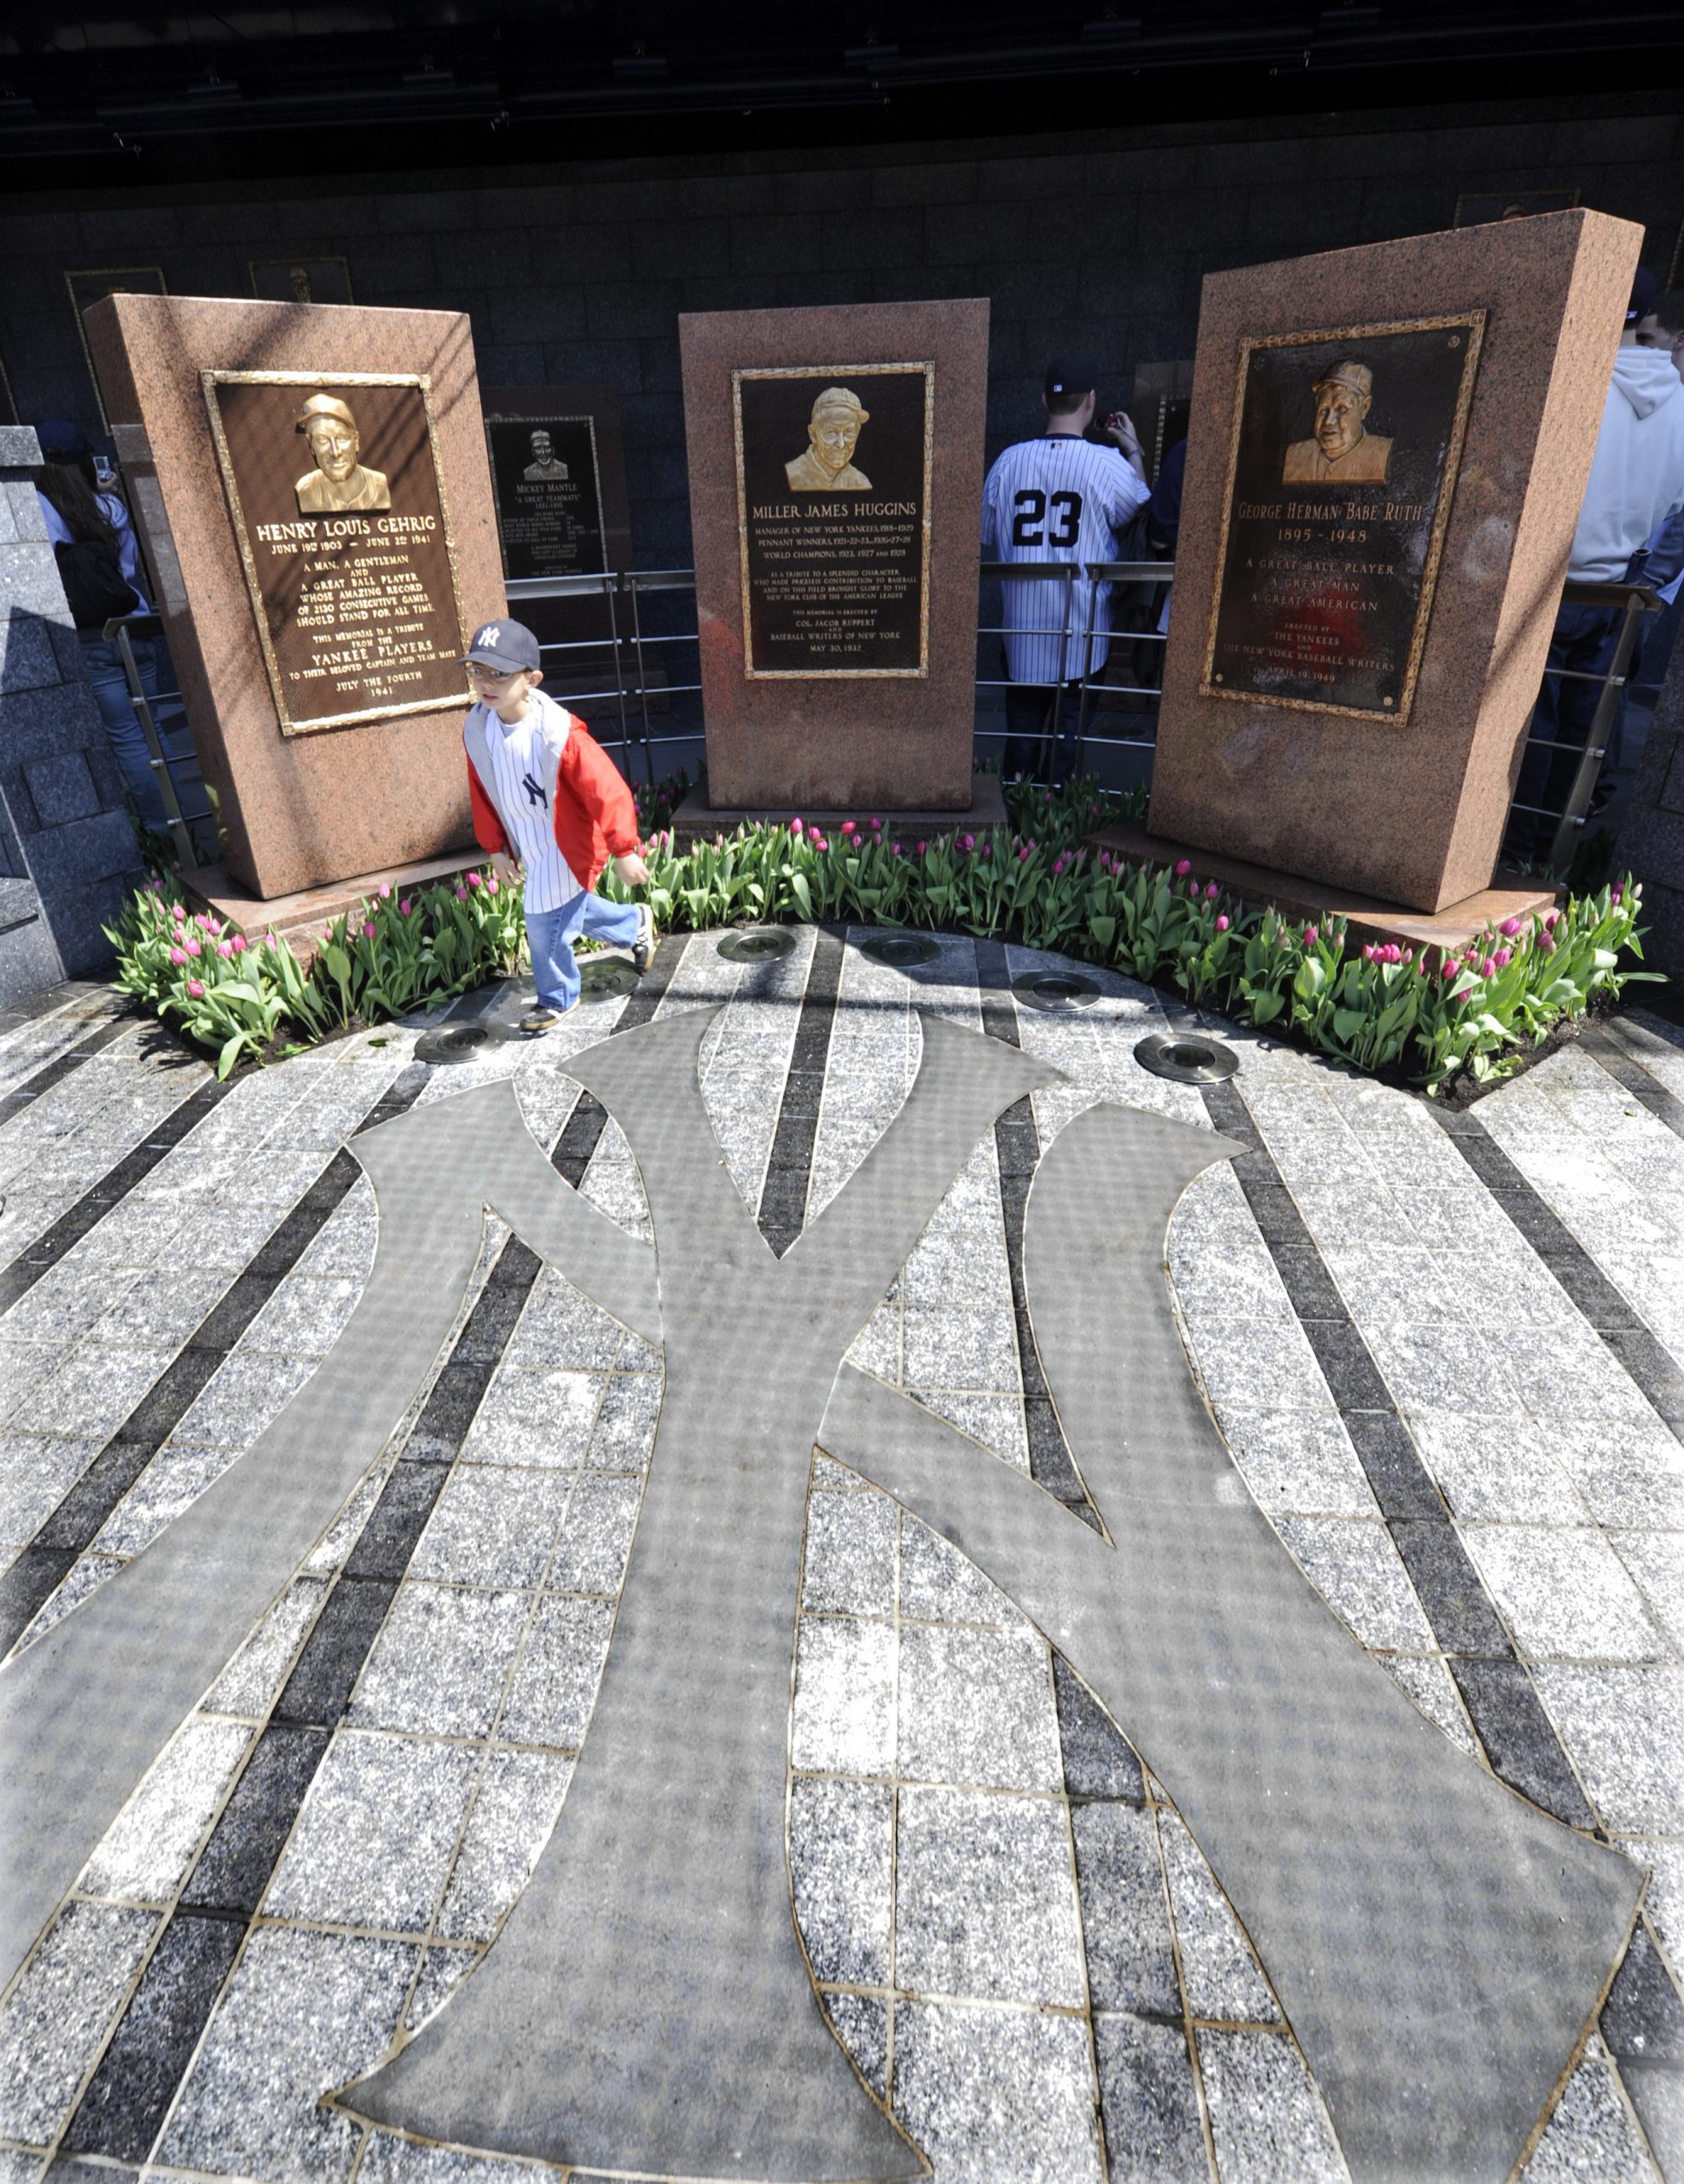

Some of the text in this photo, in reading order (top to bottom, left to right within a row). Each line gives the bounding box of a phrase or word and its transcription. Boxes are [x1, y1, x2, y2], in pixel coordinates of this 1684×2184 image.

[517, 484, 578, 493] MICKEY MANTLE
[753, 502, 916, 519] MILLER JAMES HUGGINS
[1013, 490, 1083, 548] 23
[1239, 502, 1282, 520] GEORGE
[1287, 502, 1338, 520] HERMAN
[1385, 502, 1422, 521] RUTH
[256, 515, 436, 541] HENRY LOUIS GEHRIG
[755, 526, 789, 535] MANAGER
[804, 526, 822, 534] NEW
[1279, 528, 1311, 542] 1895
[1331, 529, 1366, 543] 1948
[271, 543, 298, 555] JUNE
[321, 540, 342, 551] 1903
[366, 538, 390, 548] JUNE
[412, 535, 430, 544] 1941
[758, 538, 793, 547] PENNANT
[305, 564, 310, 572] A
[355, 555, 409, 567] GENTLEMAN
[1246, 559, 1394, 575] A GREAT BALL PLAYER
[313, 579, 345, 590] GREAT
[351, 577, 375, 587] BALL
[381, 573, 418, 584] PLAYER
[1272, 578, 1361, 592] A GREAT MAN
[300, 584, 423, 603] WHOSE AMAZING RECORD
[1251, 593, 1379, 612] A GREAT AMERICAN
[298, 594, 428, 615] OF 2130 CONSECUTIVE GAMES
[297, 614, 334, 626] SHOULD
[340, 611, 369, 621] STAND
[373, 609, 390, 618] FOR
[395, 606, 409, 615] ALL
[313, 636, 331, 644] THIS
[335, 630, 374, 641] MEMORIAL
[395, 623, 424, 634] TRIBUTE
[1285, 623, 1317, 631] ERECTED
[478, 626, 501, 648] NY
[1275, 632, 1340, 646] THE YANKEES
[312, 640, 433, 666] YANKEE PLAYERS
[1223, 643, 1395, 671] THE NEW YORK BASEBALL WRITERS
[289, 672, 299, 681] TO
[303, 669, 327, 678] THEIR
[330, 664, 362, 675] BELOVED
[366, 659, 395, 669] CAPTAIN
[417, 653, 435, 662] TEAM
[439, 650, 456, 659] MATE
[1268, 666, 1295, 677] APRIL
[1313, 671, 1335, 682] 1949
[336, 671, 422, 692] JULY THE FOURTH
[371, 688, 393, 697] 1941
